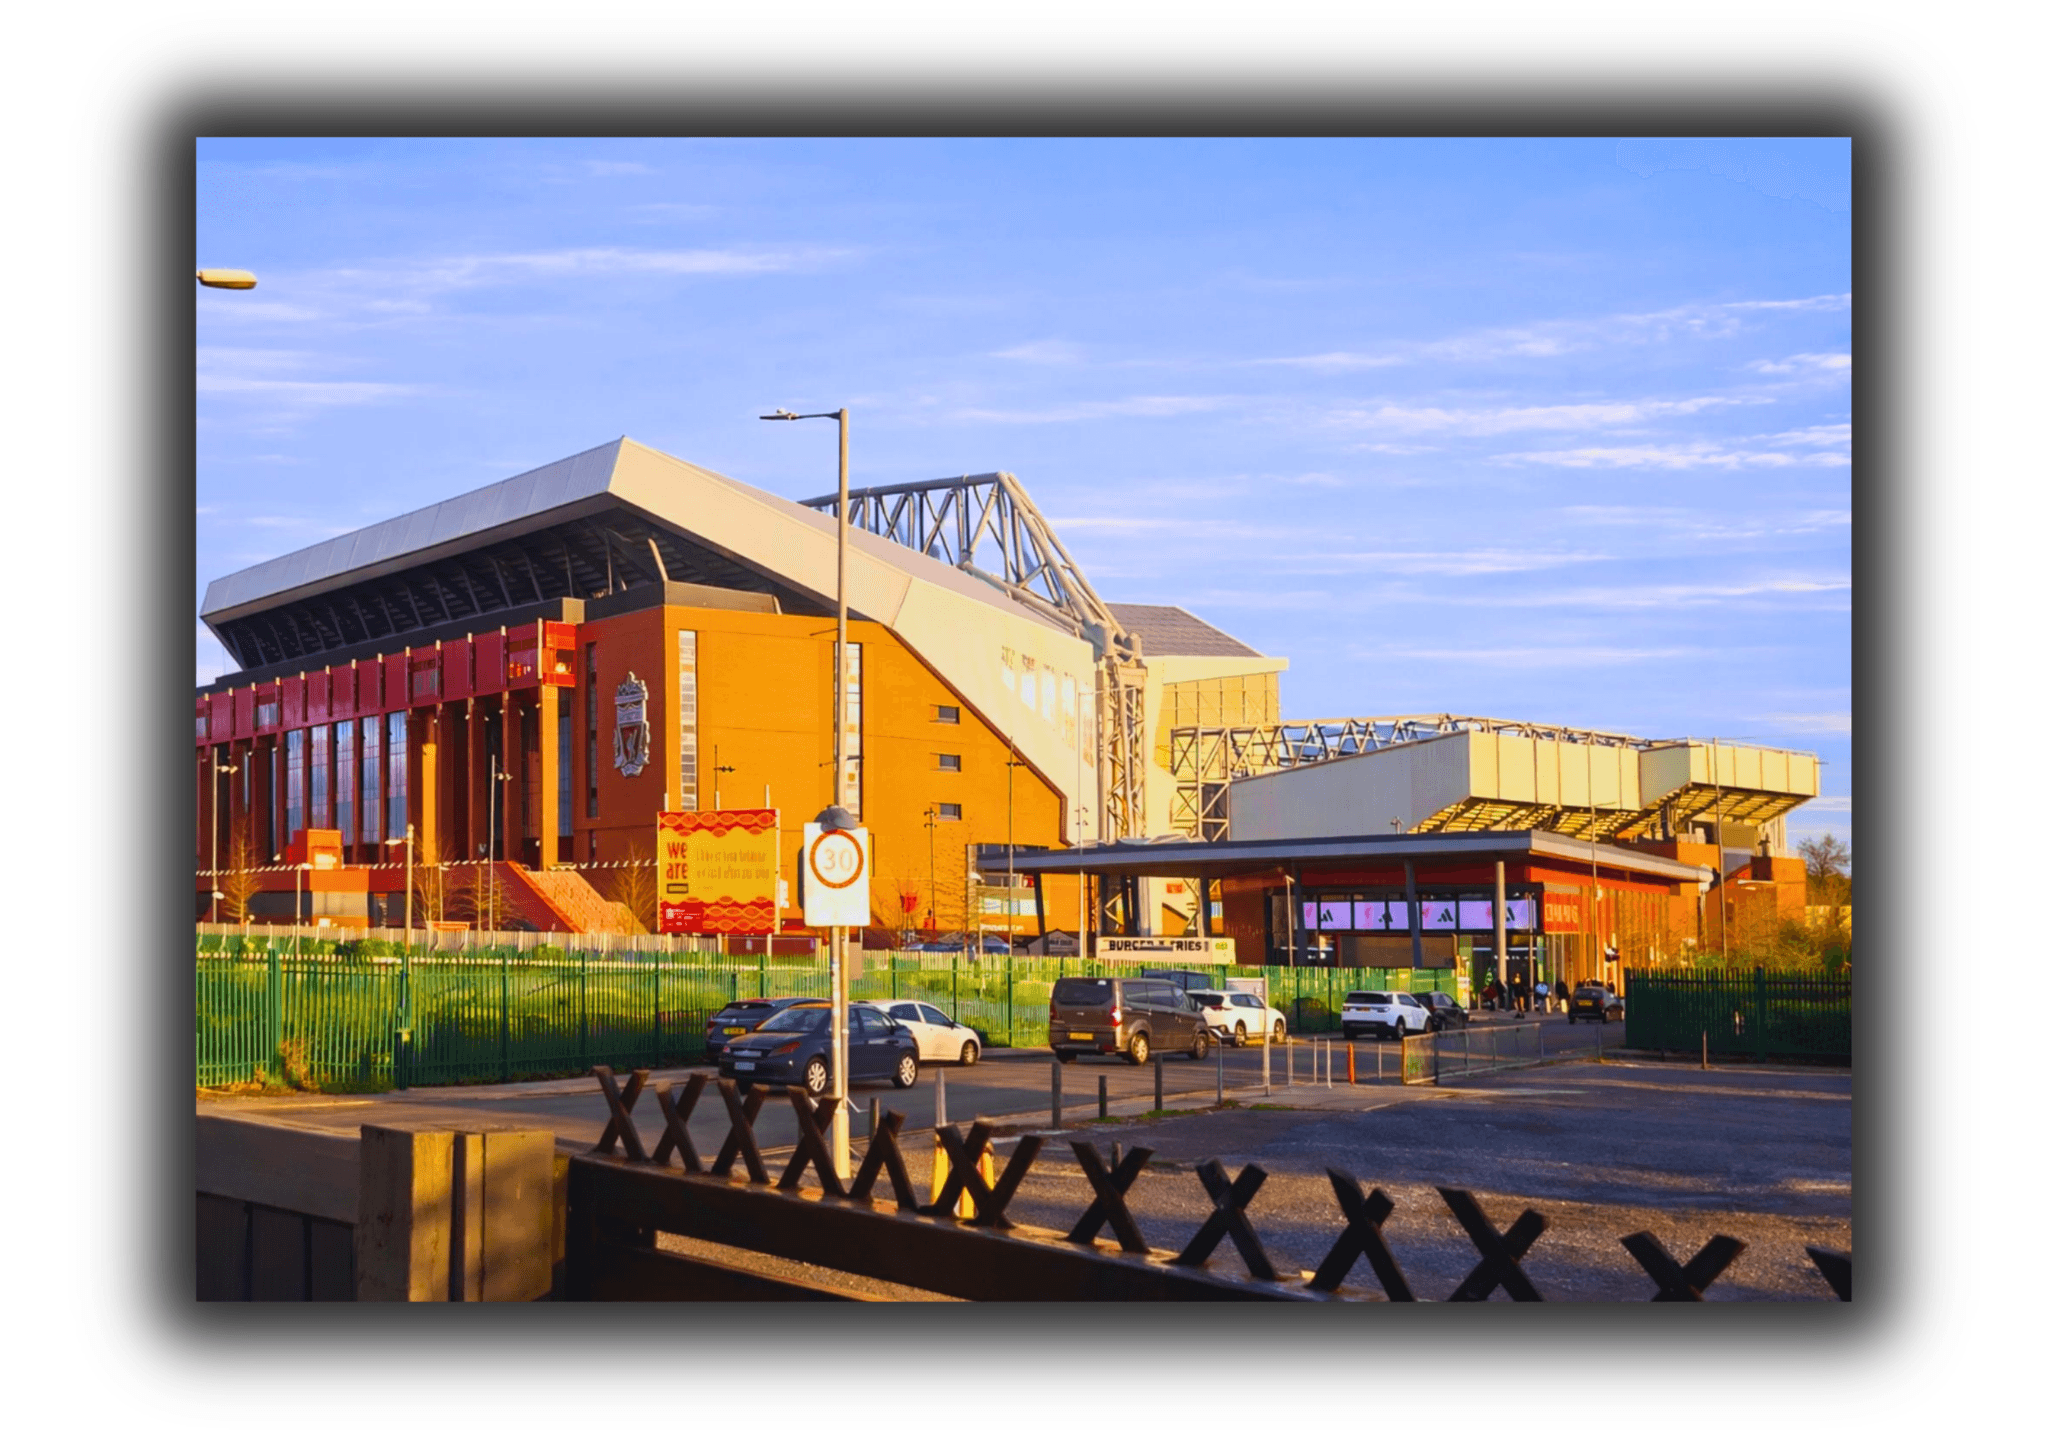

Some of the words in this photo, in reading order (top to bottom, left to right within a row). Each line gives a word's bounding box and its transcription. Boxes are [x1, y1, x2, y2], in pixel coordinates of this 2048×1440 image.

[666, 841, 688, 859] we
[823, 847, 854, 872] 30
[666, 862, 688, 880] are
